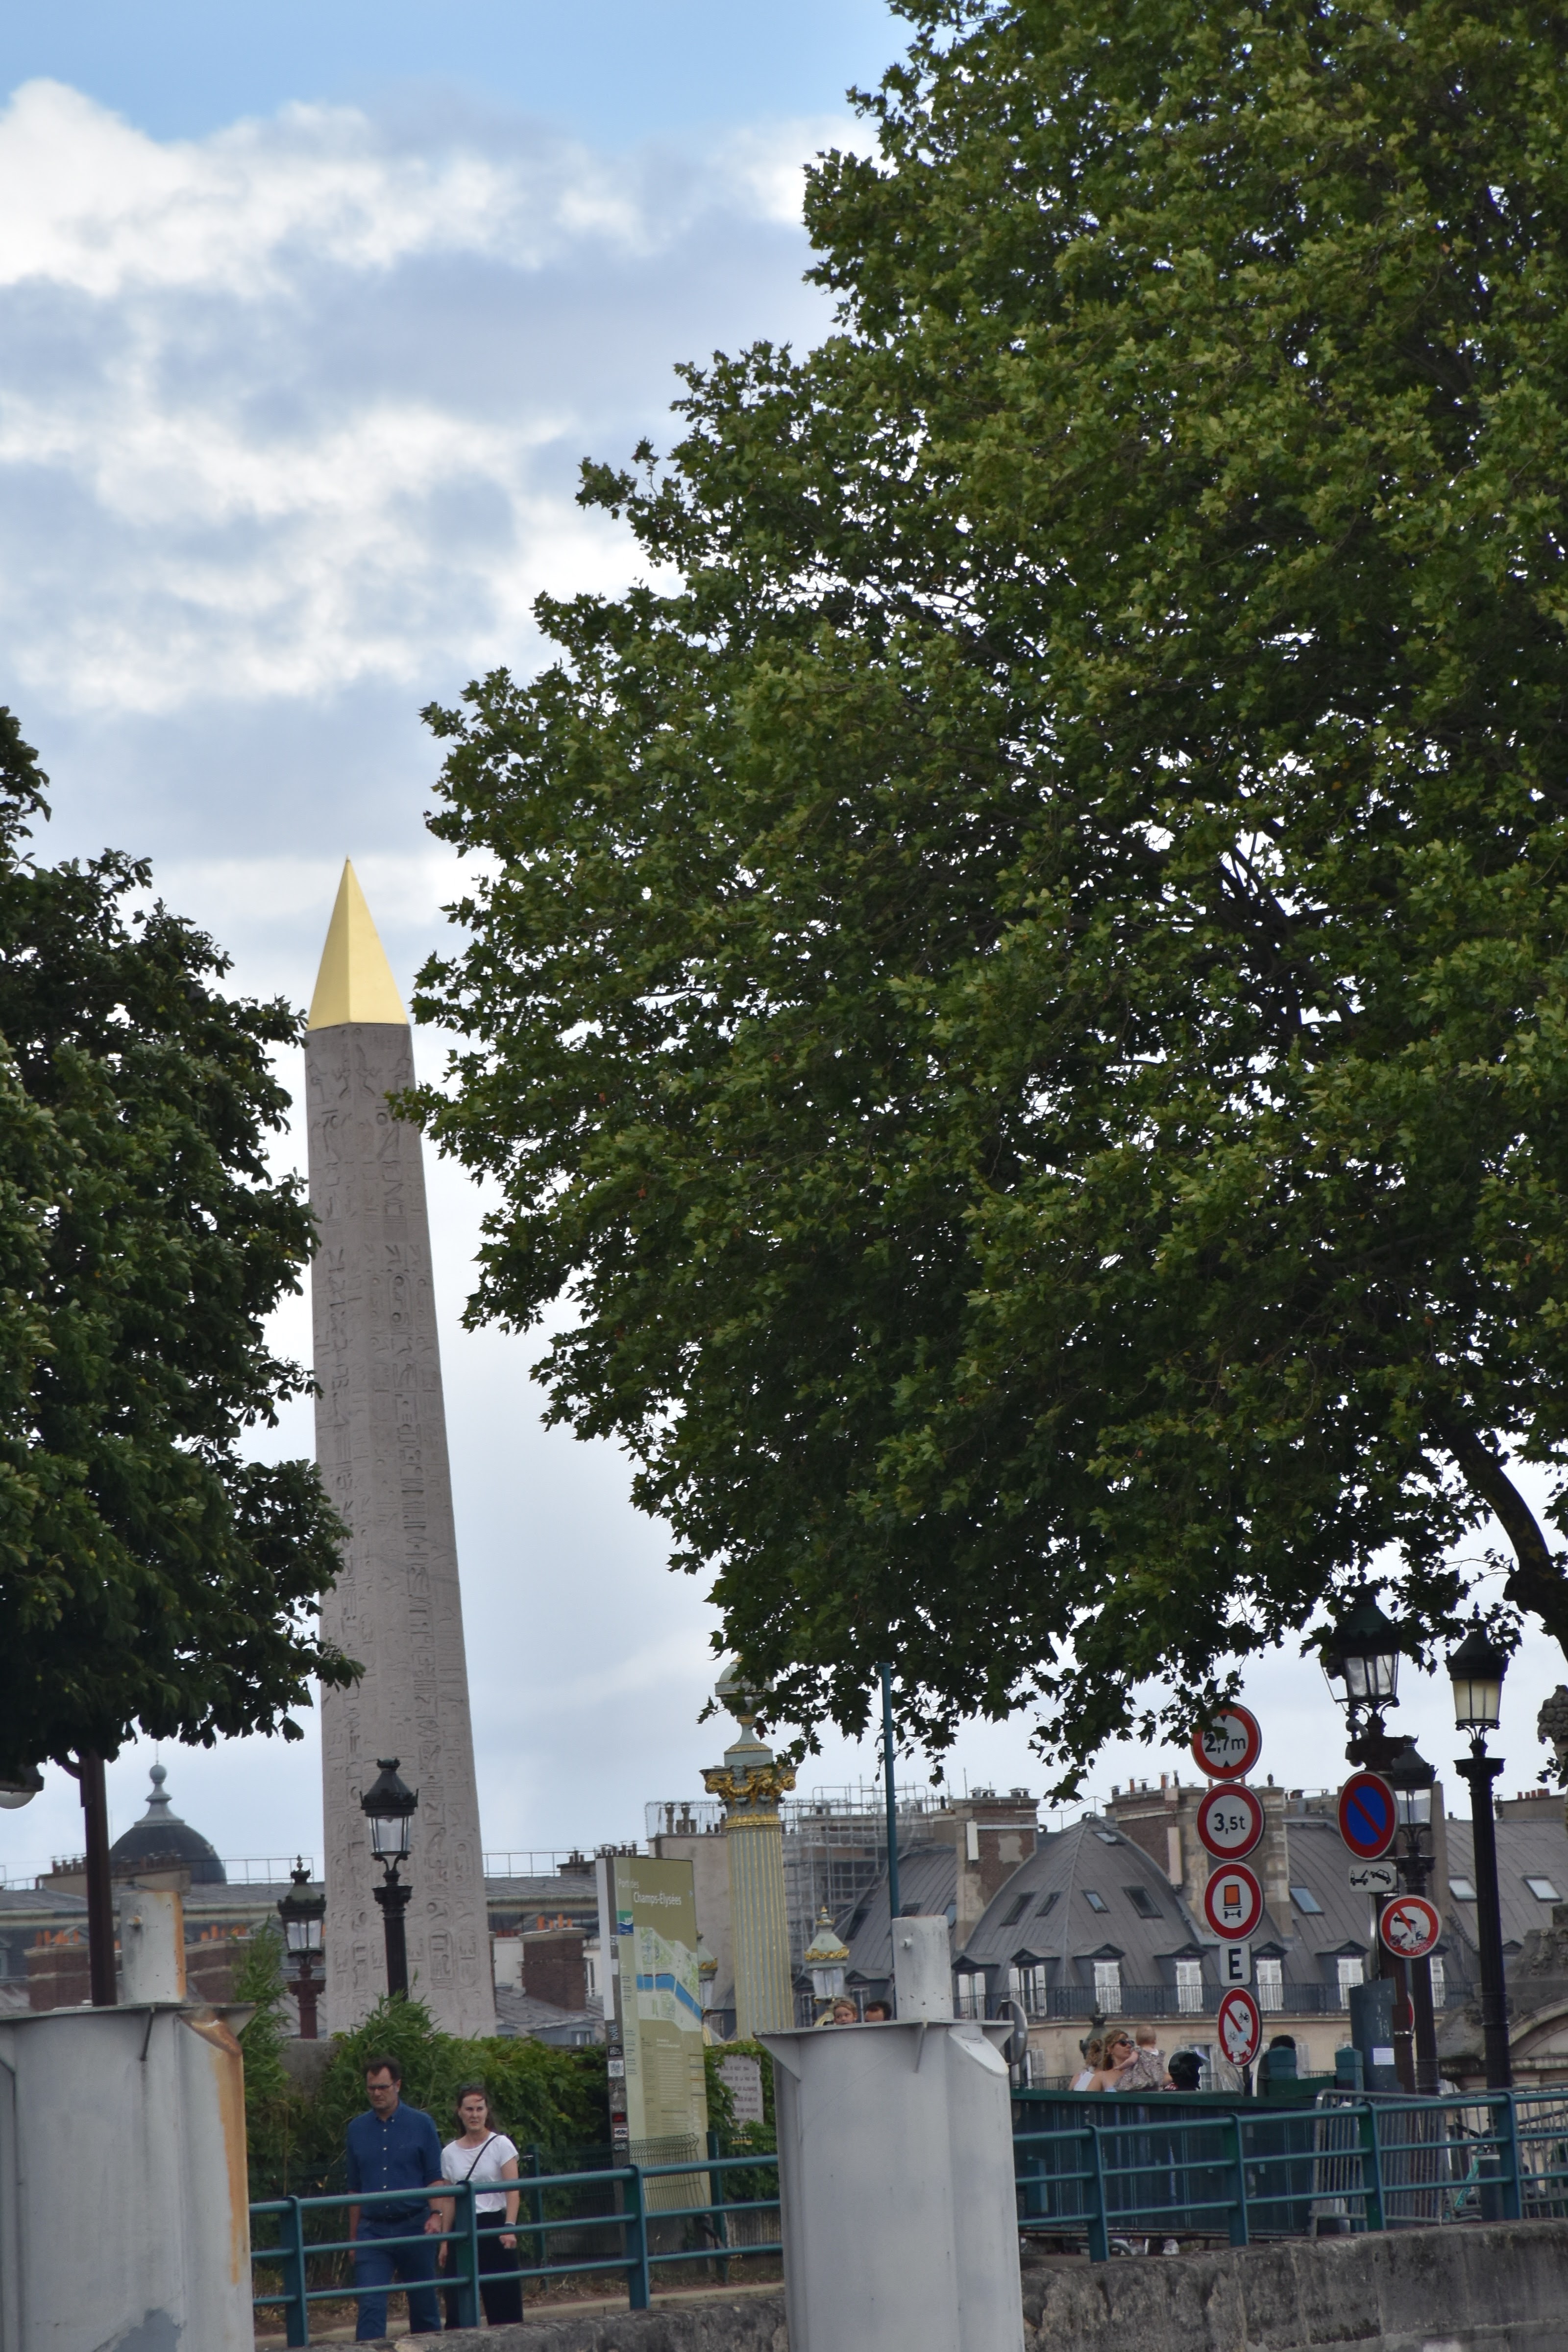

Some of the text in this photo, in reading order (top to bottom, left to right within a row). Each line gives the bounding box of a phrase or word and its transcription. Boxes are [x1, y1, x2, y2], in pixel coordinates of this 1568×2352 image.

[1213, 1812, 1246, 1835] 3,5t
[618, 1878, 639, 1888] Port des
[633, 1890, 682, 1908] Champs-Élysées
[1228, 1948, 1243, 1980] E
